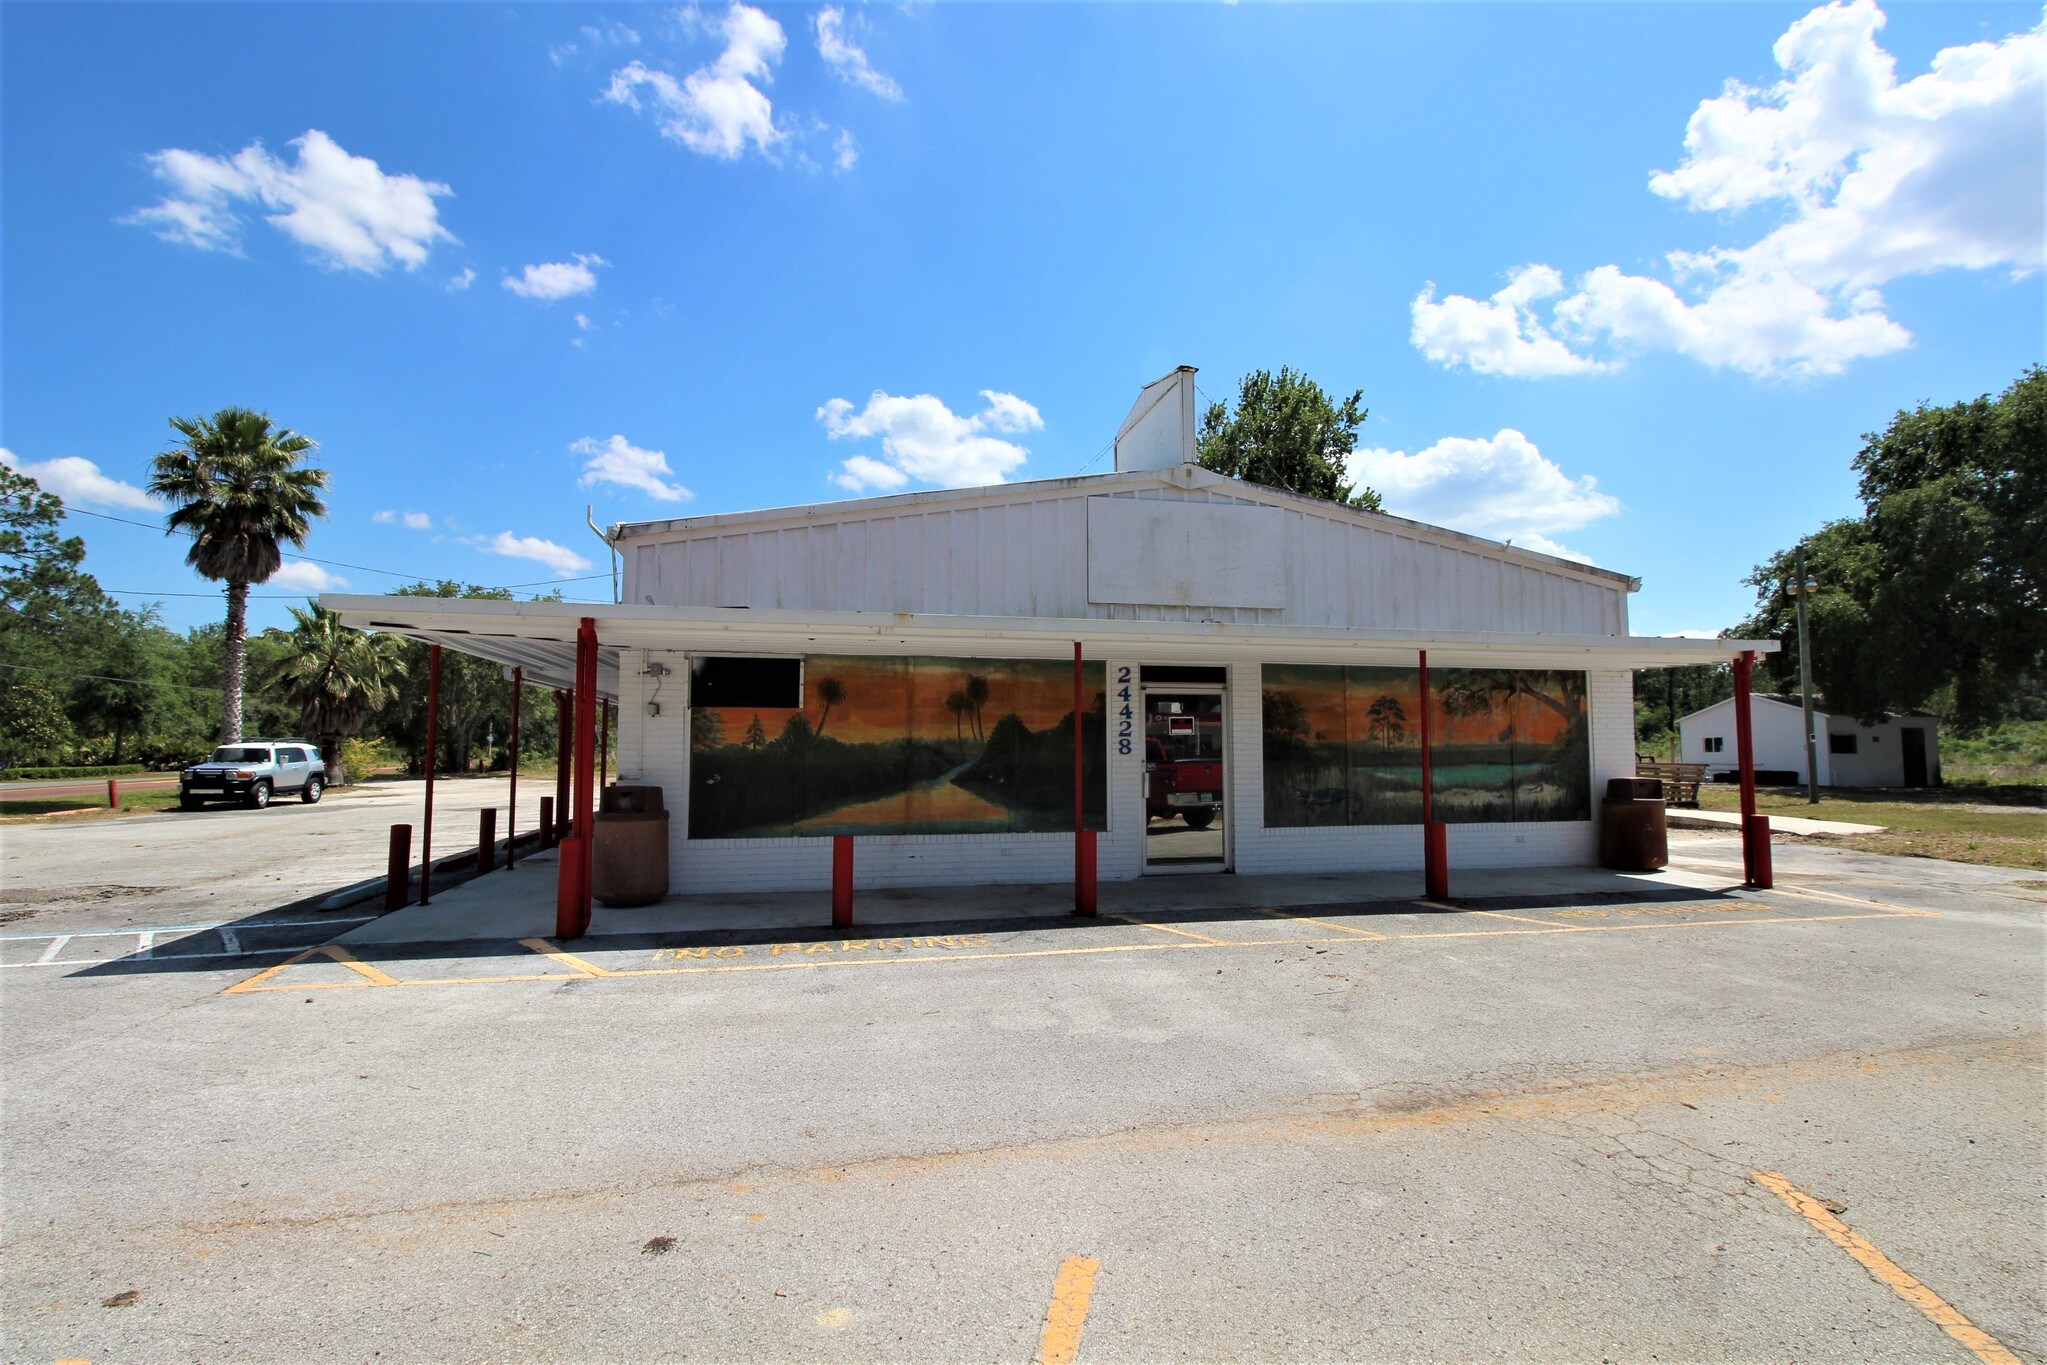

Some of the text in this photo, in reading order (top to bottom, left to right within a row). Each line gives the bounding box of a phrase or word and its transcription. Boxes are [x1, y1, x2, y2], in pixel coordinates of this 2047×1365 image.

[1117, 666, 1133, 755] 24428
[673, 935, 990, 961] NO PARKING
